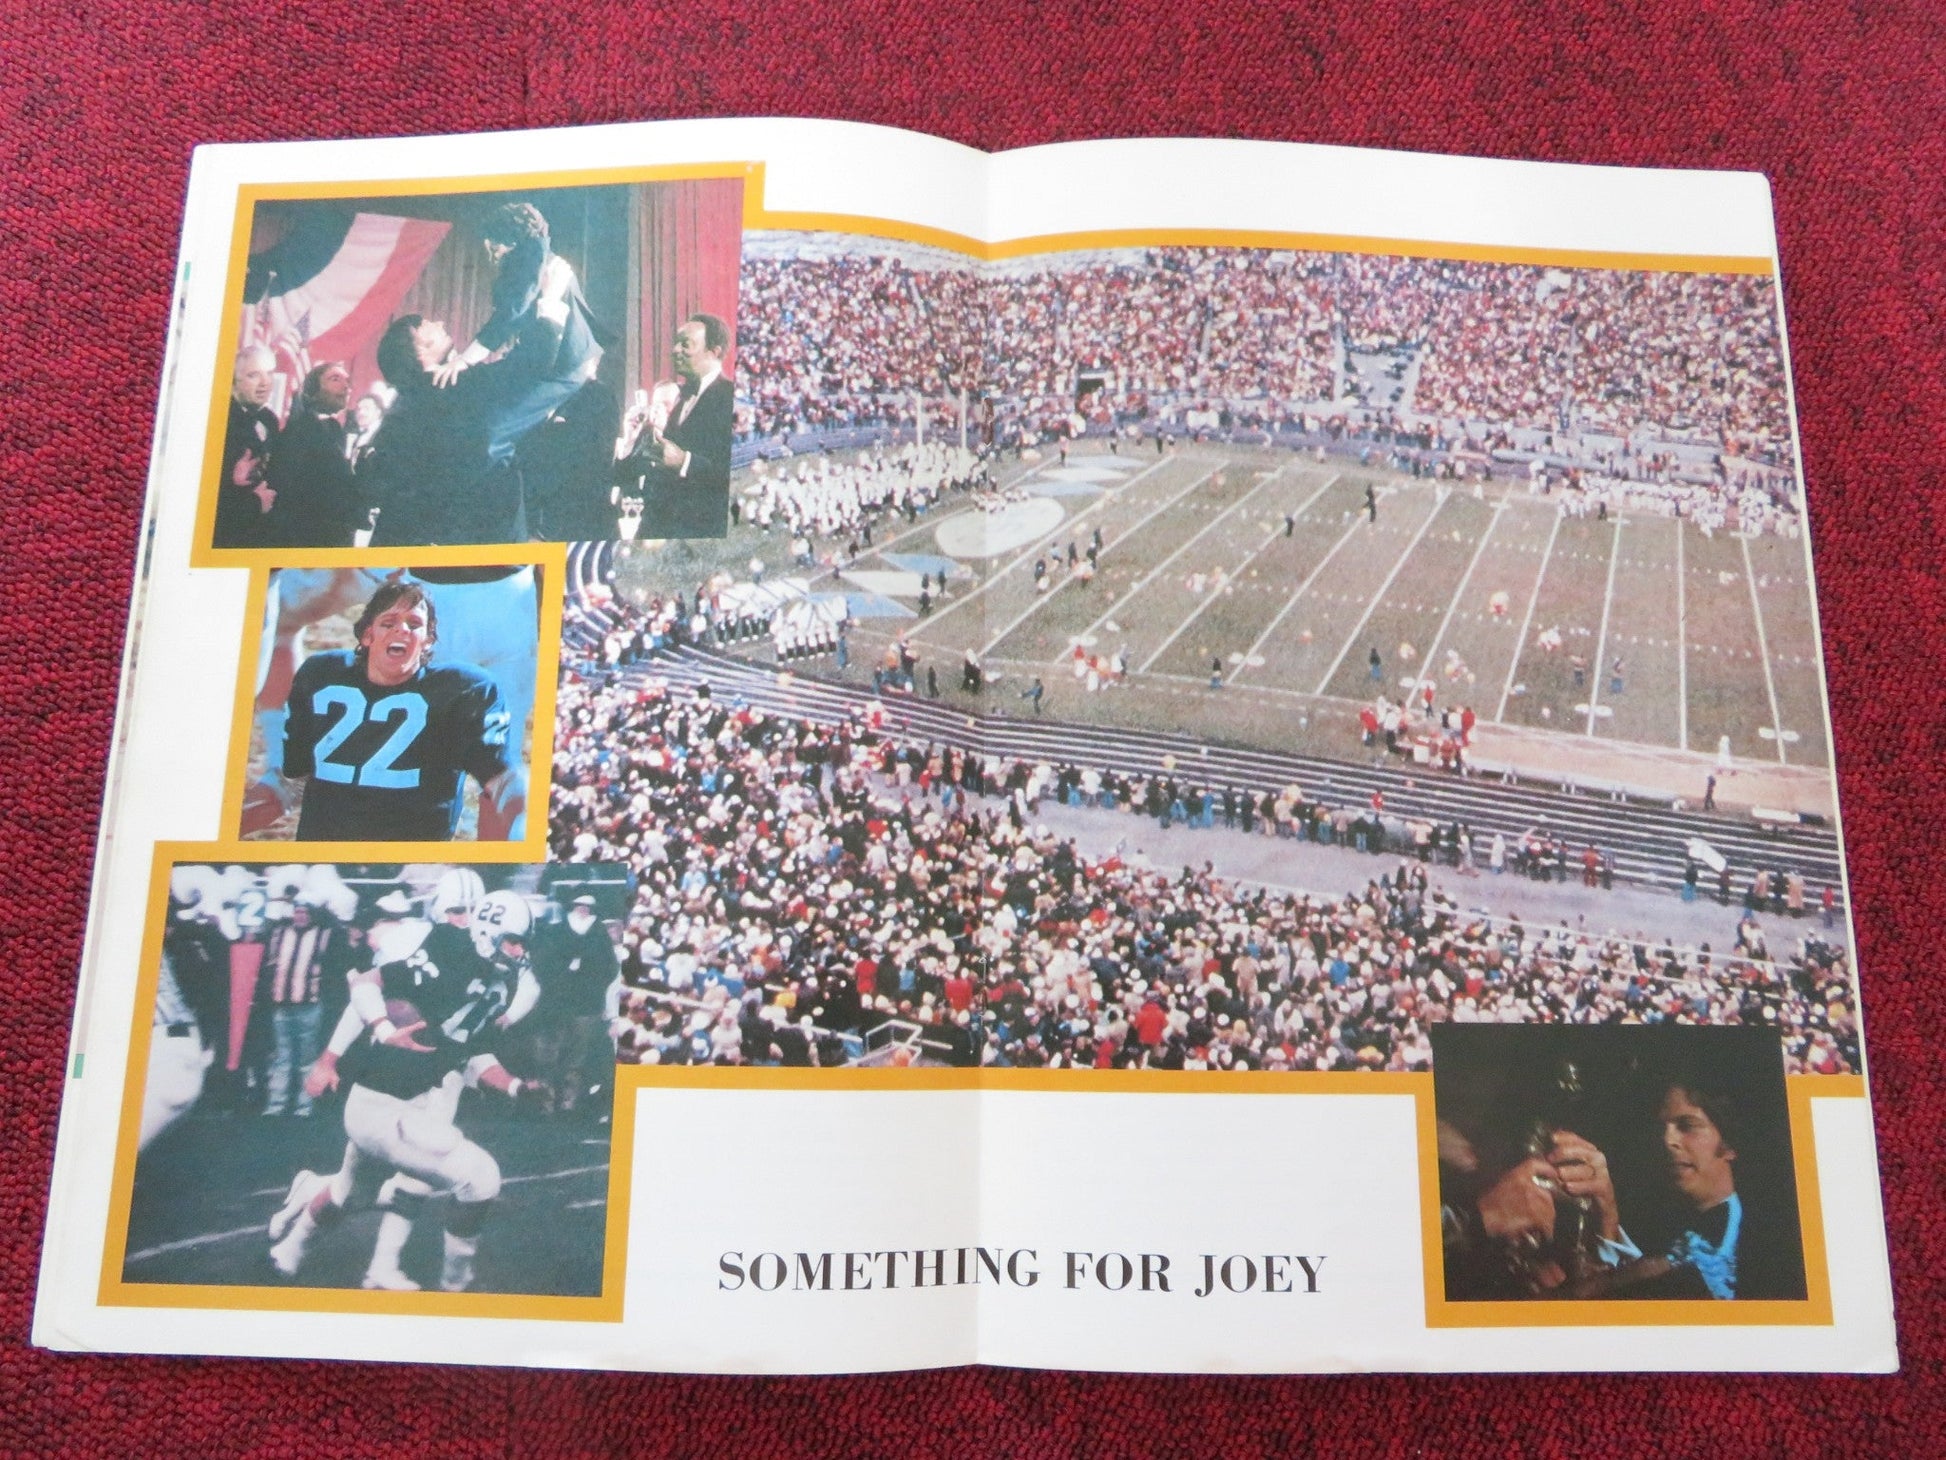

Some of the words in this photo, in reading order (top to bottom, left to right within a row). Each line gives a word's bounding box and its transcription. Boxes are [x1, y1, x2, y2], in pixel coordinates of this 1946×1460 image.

[312, 684, 429, 789] 22
[477, 901, 506, 926] 22
[717, 1247, 1041, 1291] SOMETHING
[1062, 1251, 1174, 1292] FOR
[1194, 1254, 1328, 1298] JOEY
